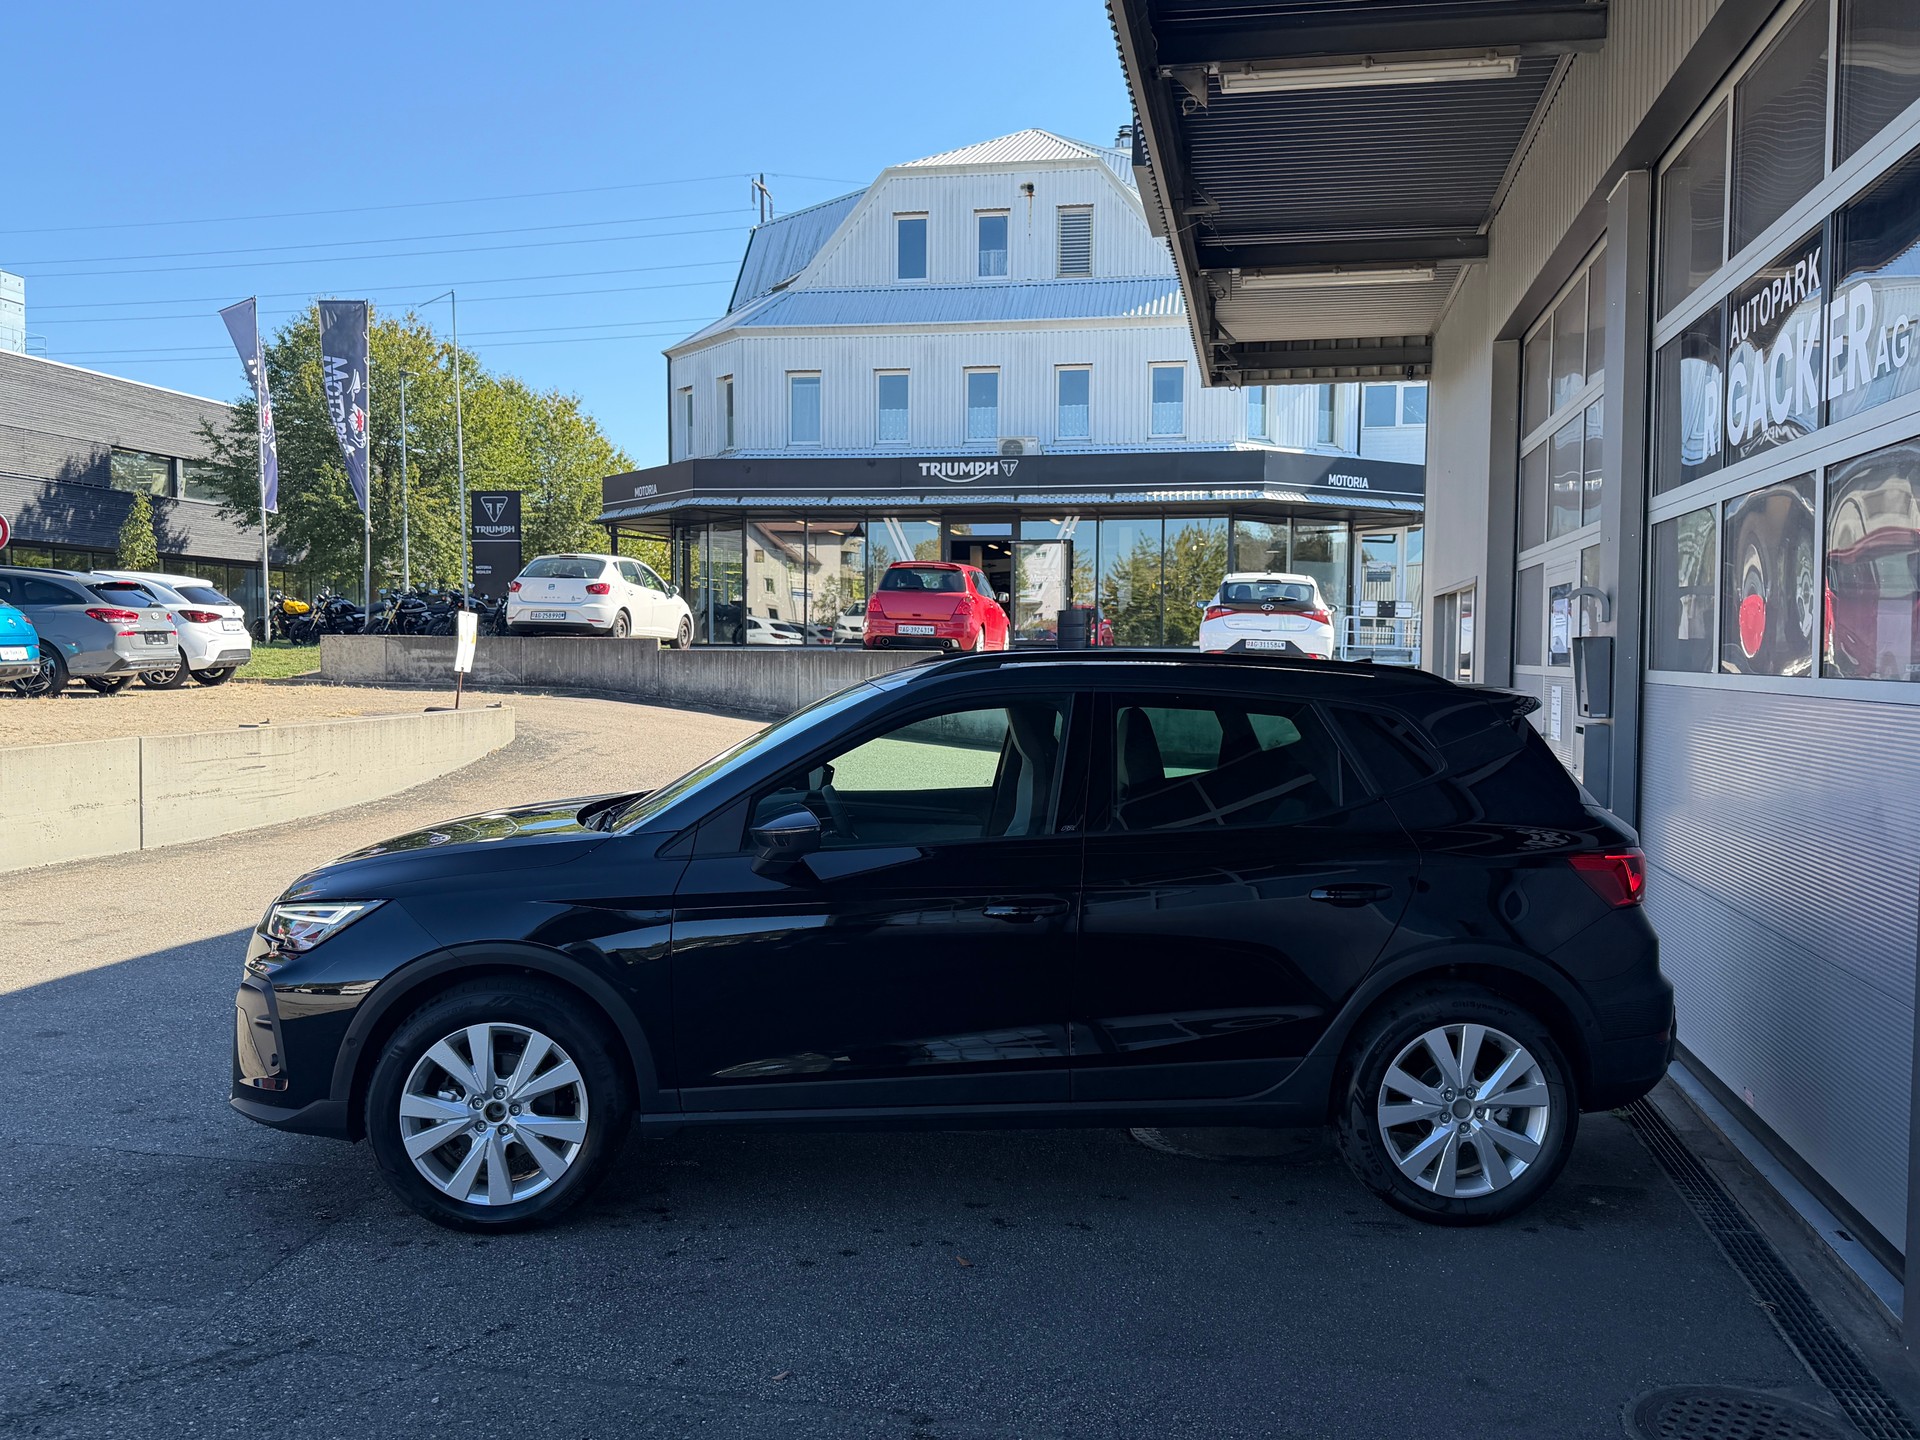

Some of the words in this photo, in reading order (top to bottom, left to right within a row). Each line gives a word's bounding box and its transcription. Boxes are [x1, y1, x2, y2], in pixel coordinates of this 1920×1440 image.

[1730, 247, 1821, 348] AUTOPARK
[1873, 314, 1910, 379] AG
[918, 461, 999, 483] TRIUMPH
[1328, 473, 1369, 489] MOTORIA
[634, 484, 658, 498] MOTORIA
[474, 525, 515, 537] TRIUMPH
